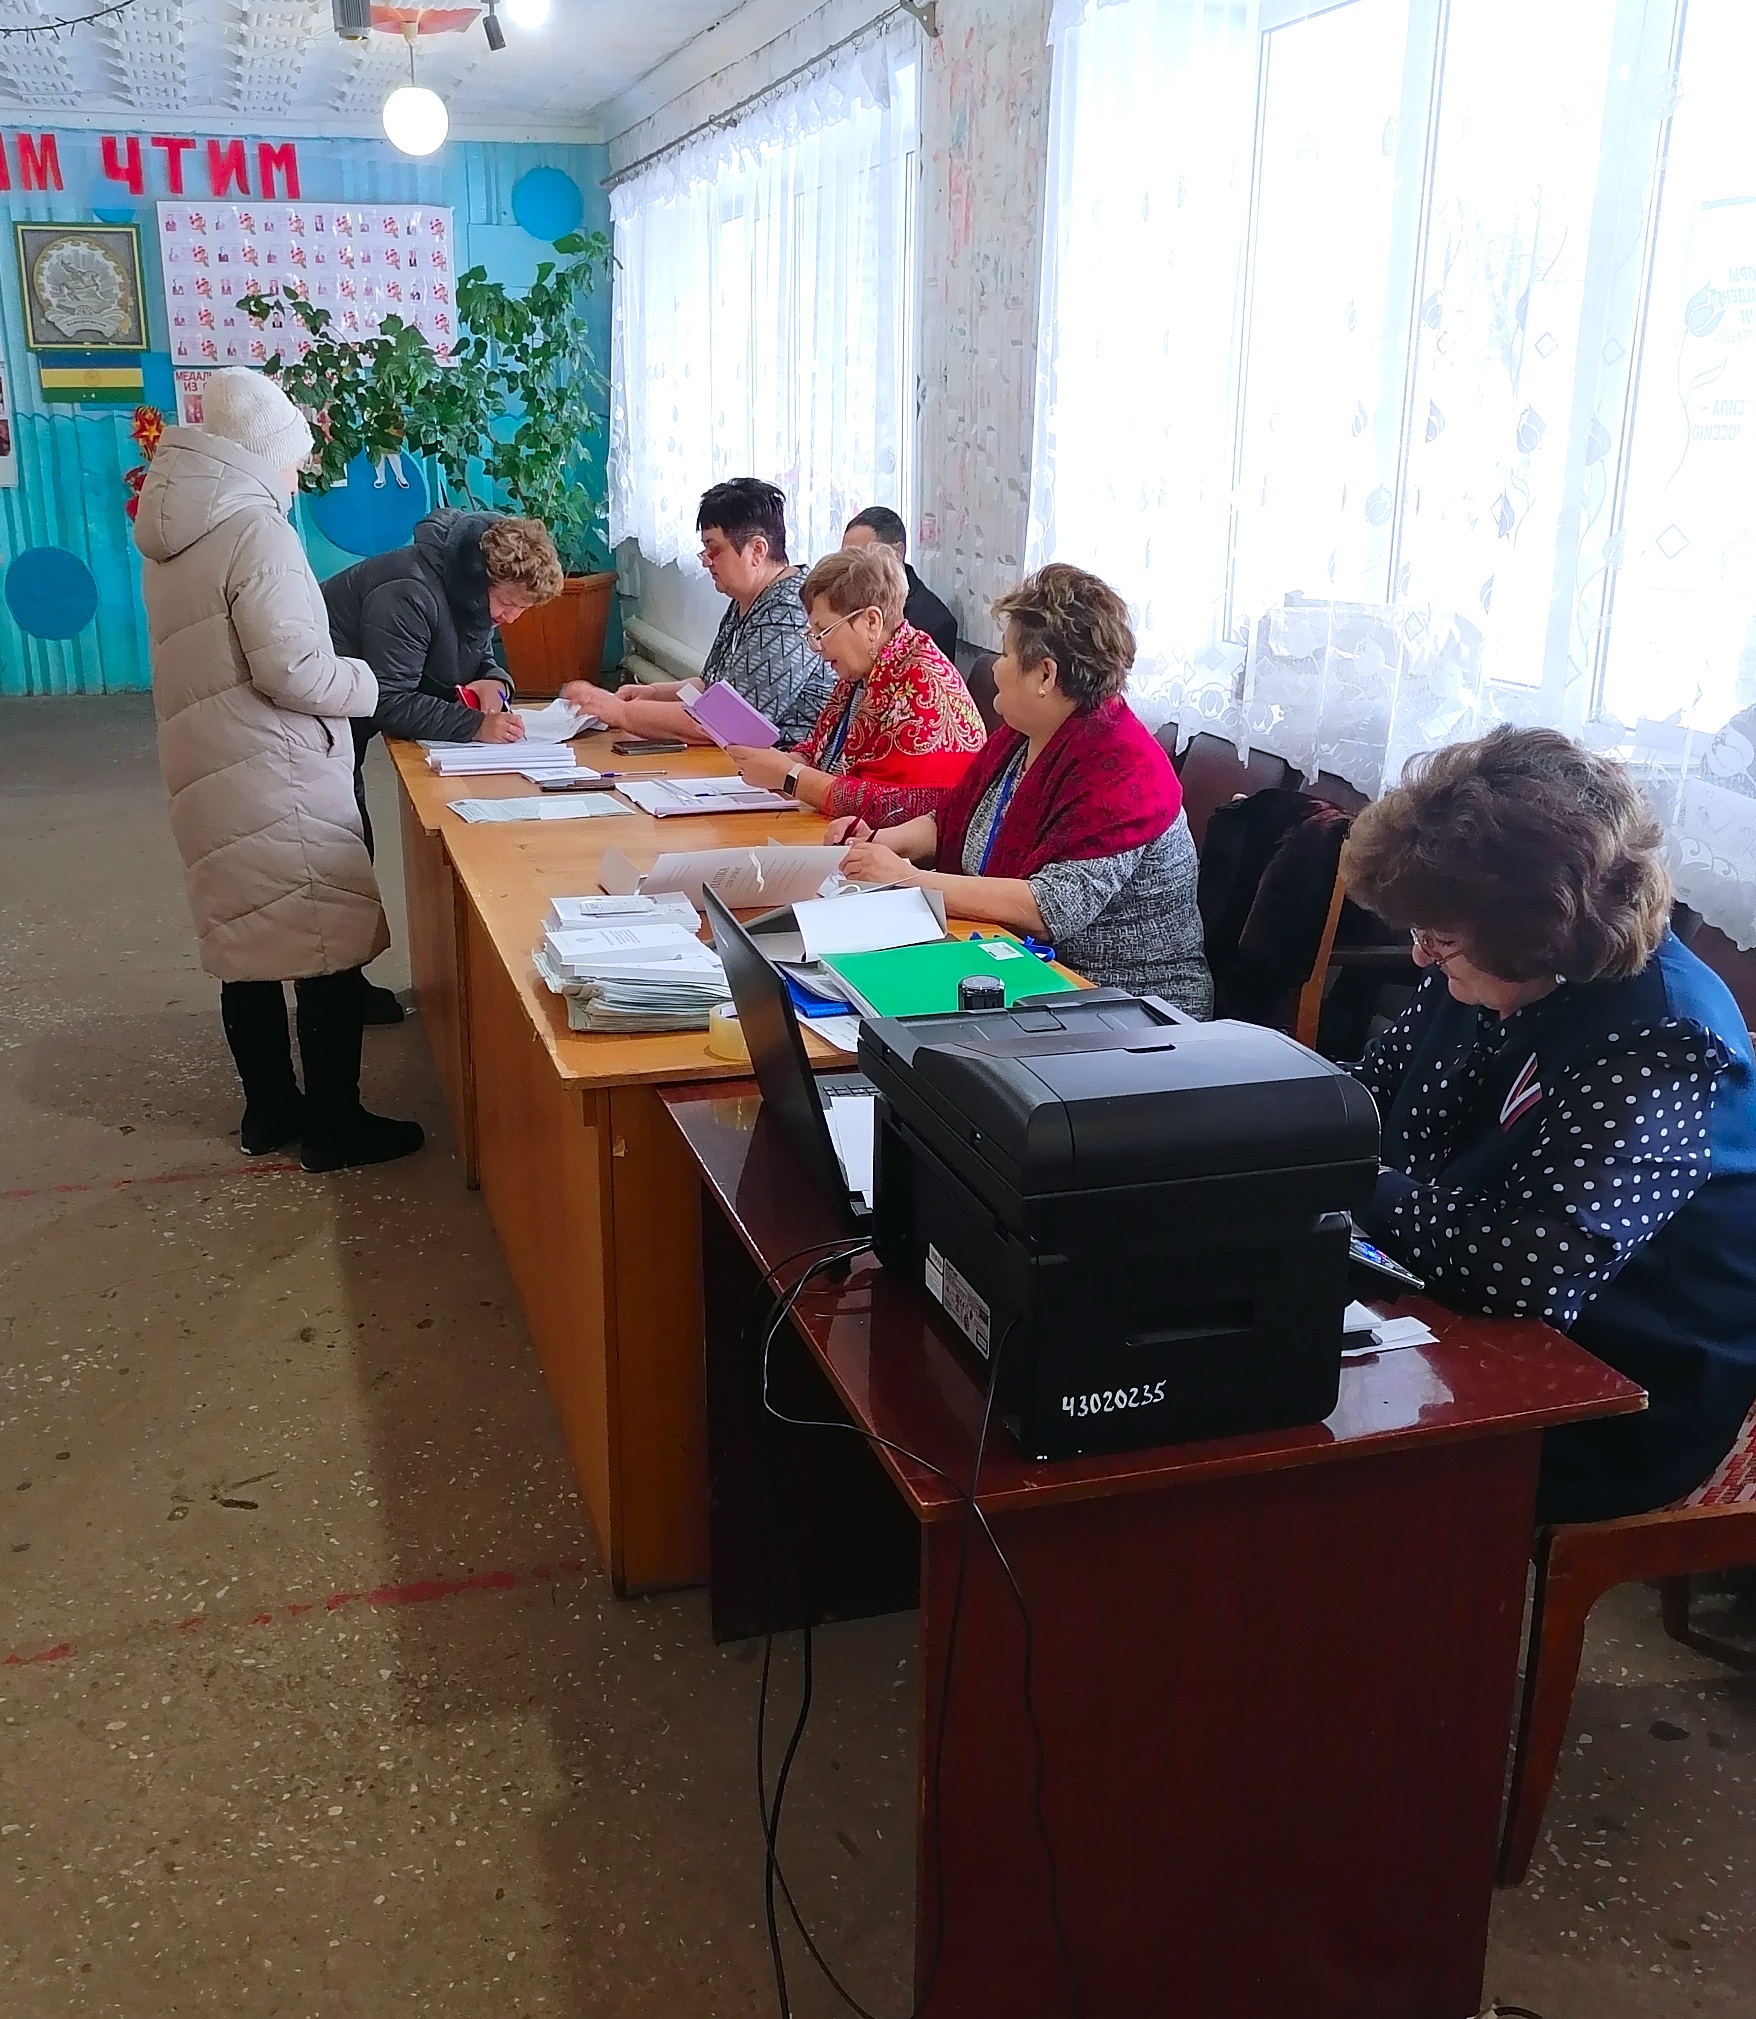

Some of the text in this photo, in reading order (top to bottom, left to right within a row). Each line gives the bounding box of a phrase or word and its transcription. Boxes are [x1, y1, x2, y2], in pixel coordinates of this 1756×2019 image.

[0, 131, 301, 200] М ЧТИМ
[184, 382, 198, 392] ИЗ
[1061, 1379, 1167, 1418] 43020235
